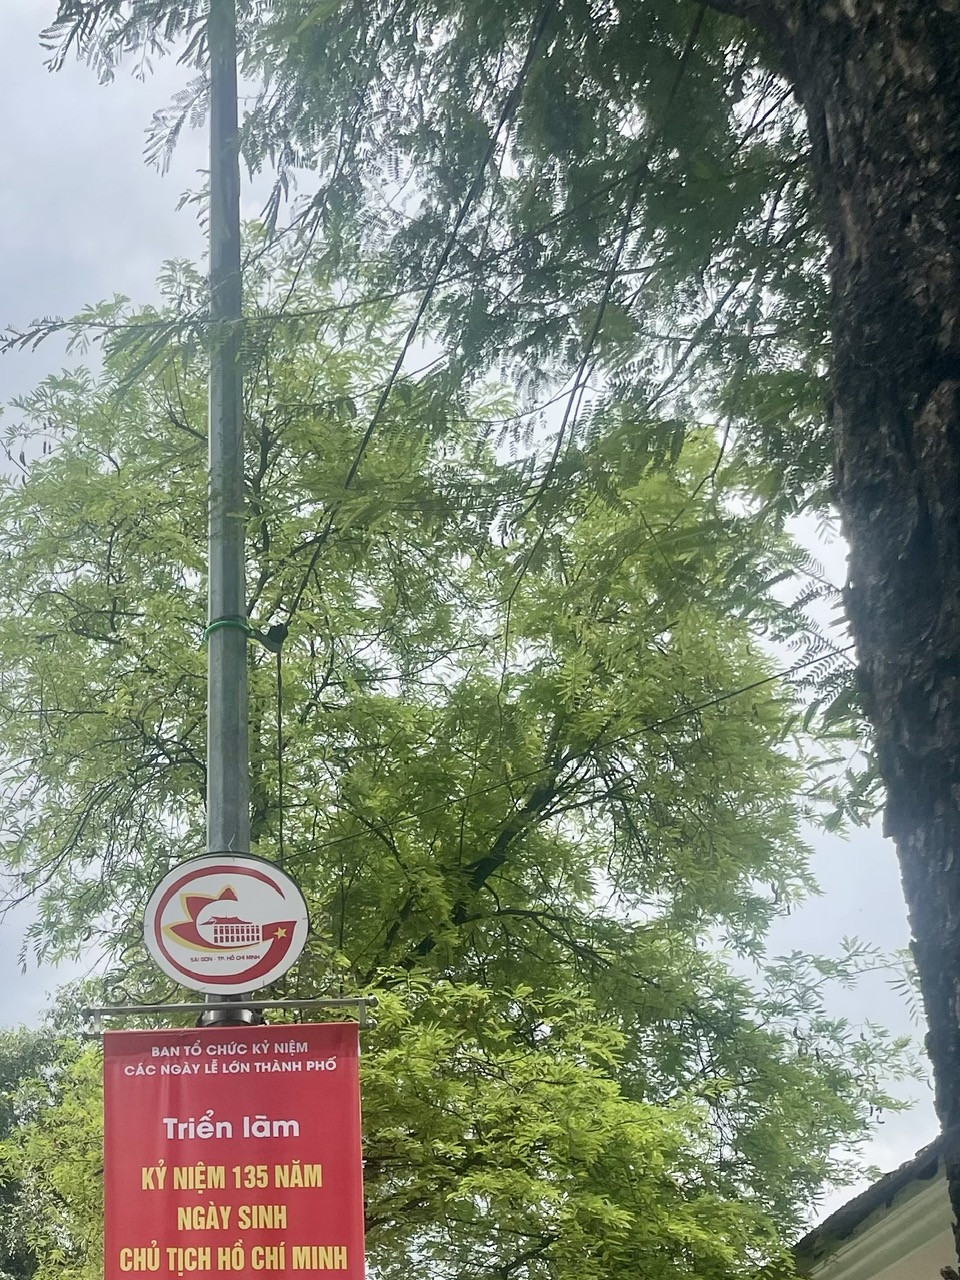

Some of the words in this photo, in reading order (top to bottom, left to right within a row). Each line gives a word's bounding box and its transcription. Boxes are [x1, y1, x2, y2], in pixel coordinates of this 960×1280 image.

[151, 1046, 180, 1057] BAN
[184, 1039, 202, 1056] TỔ
[206, 1041, 248, 1056] CHỨC
[252, 1039, 270, 1054] KỶ
[274, 1039, 308, 1056] NIỆM
[124, 1062, 157, 1076] CÁC
[160, 1061, 201, 1075] NGÀY
[204, 1058, 219, 1074] LỄ
[222, 1060, 251, 1074] LỚN
[254, 1059, 302, 1073] THÀNH
[306, 1056, 337, 1071] PHỐ
[163, 1109, 233, 1140] Triển
[243, 1115, 300, 1138] lãm
[141, 1159, 167, 1190] KỶ
[173, 1162, 225, 1194] NIỆM
[232, 1166, 269, 1189] 135
[274, 1160, 323, 1188] NĂM
[177, 1201, 232, 1231] NGÀY
[238, 1205, 287, 1230] SINH
[120, 1240, 160, 1272] CHỦ
[166, 1246, 211, 1276] TỊCH
[218, 1239, 245, 1271] HỒ
[251, 1242, 286, 1271] CHÍ
[292, 1246, 348, 1270] MINH
